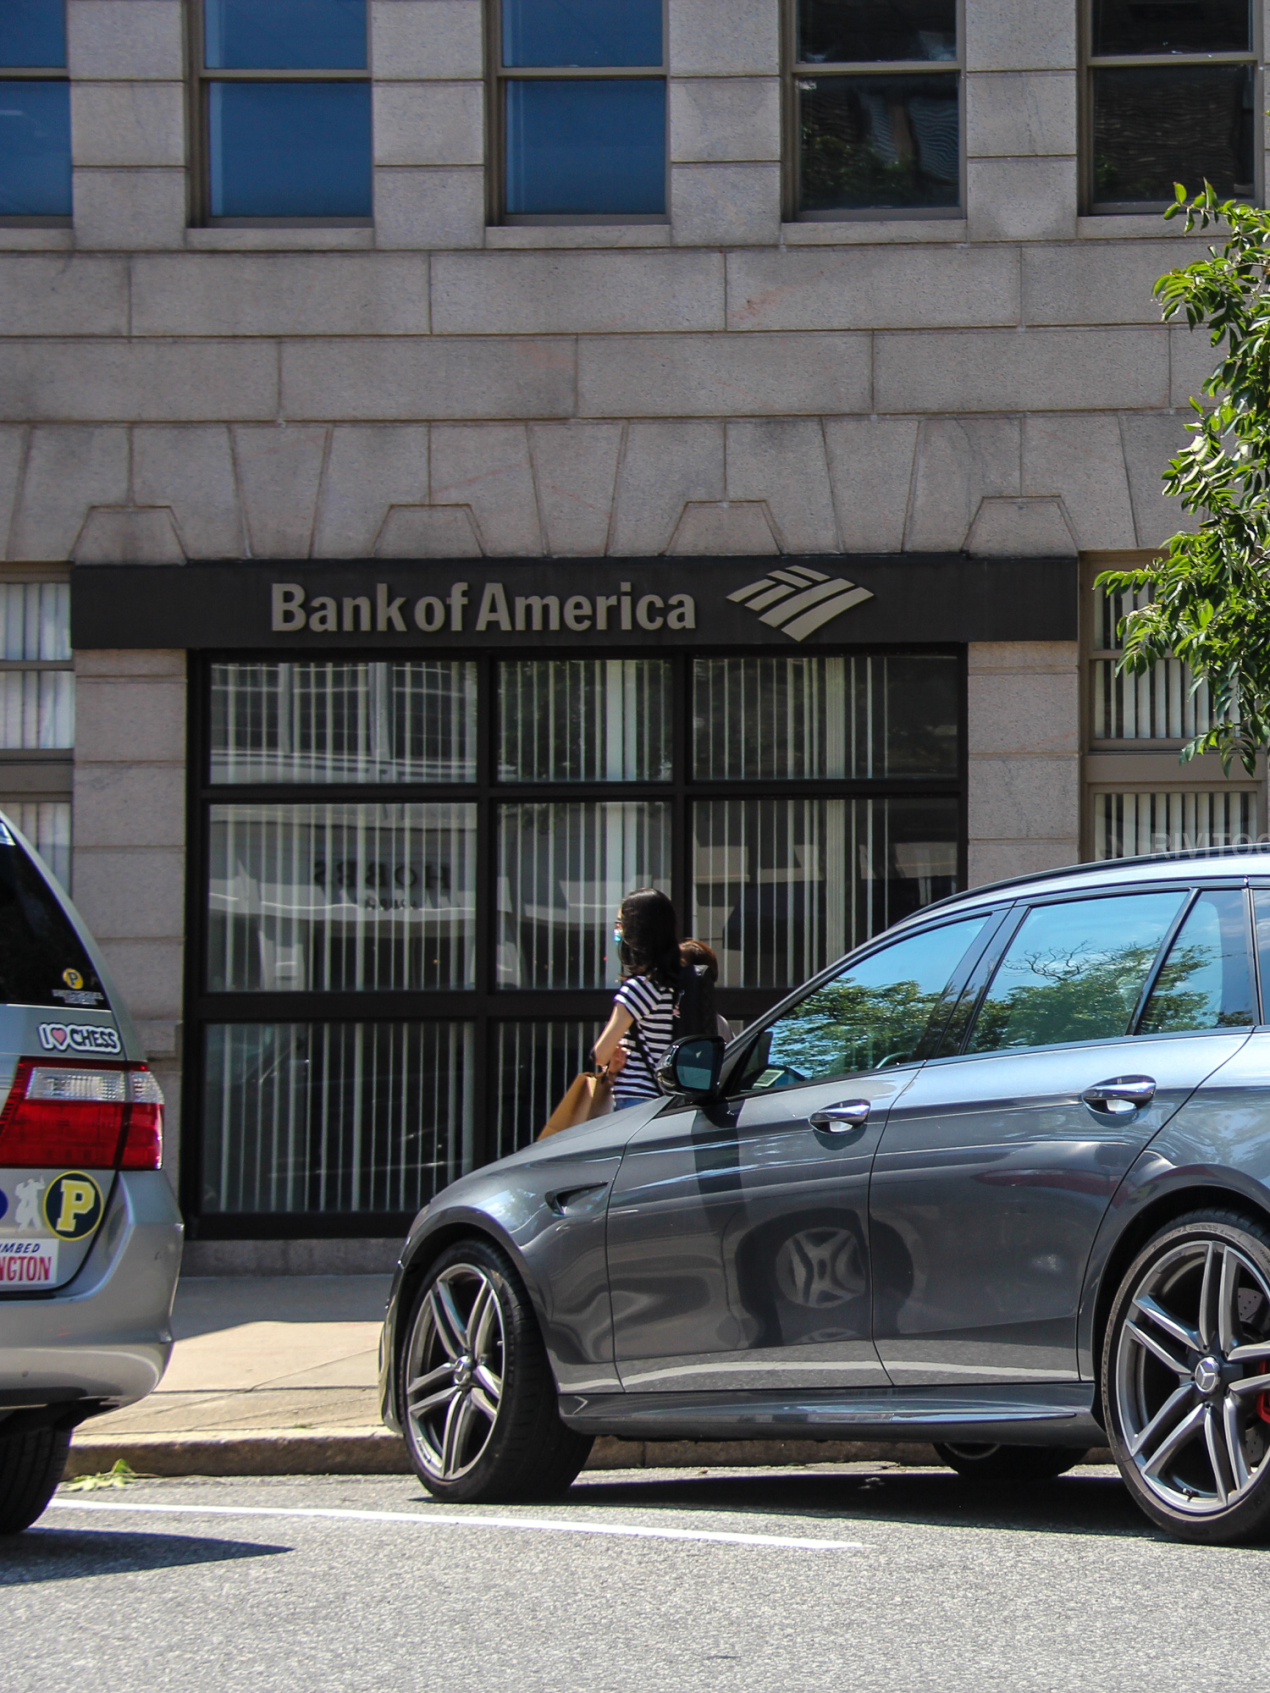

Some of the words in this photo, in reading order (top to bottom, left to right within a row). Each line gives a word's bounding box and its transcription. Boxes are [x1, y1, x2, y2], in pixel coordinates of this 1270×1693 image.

[273, 582, 407, 632] Bank
[414, 582, 469, 632] of
[475, 582, 697, 632] America
[70, 1028, 118, 1050] CHESS
[56, 1179, 96, 1233] P
[0, 1242, 41, 1254] MBED
